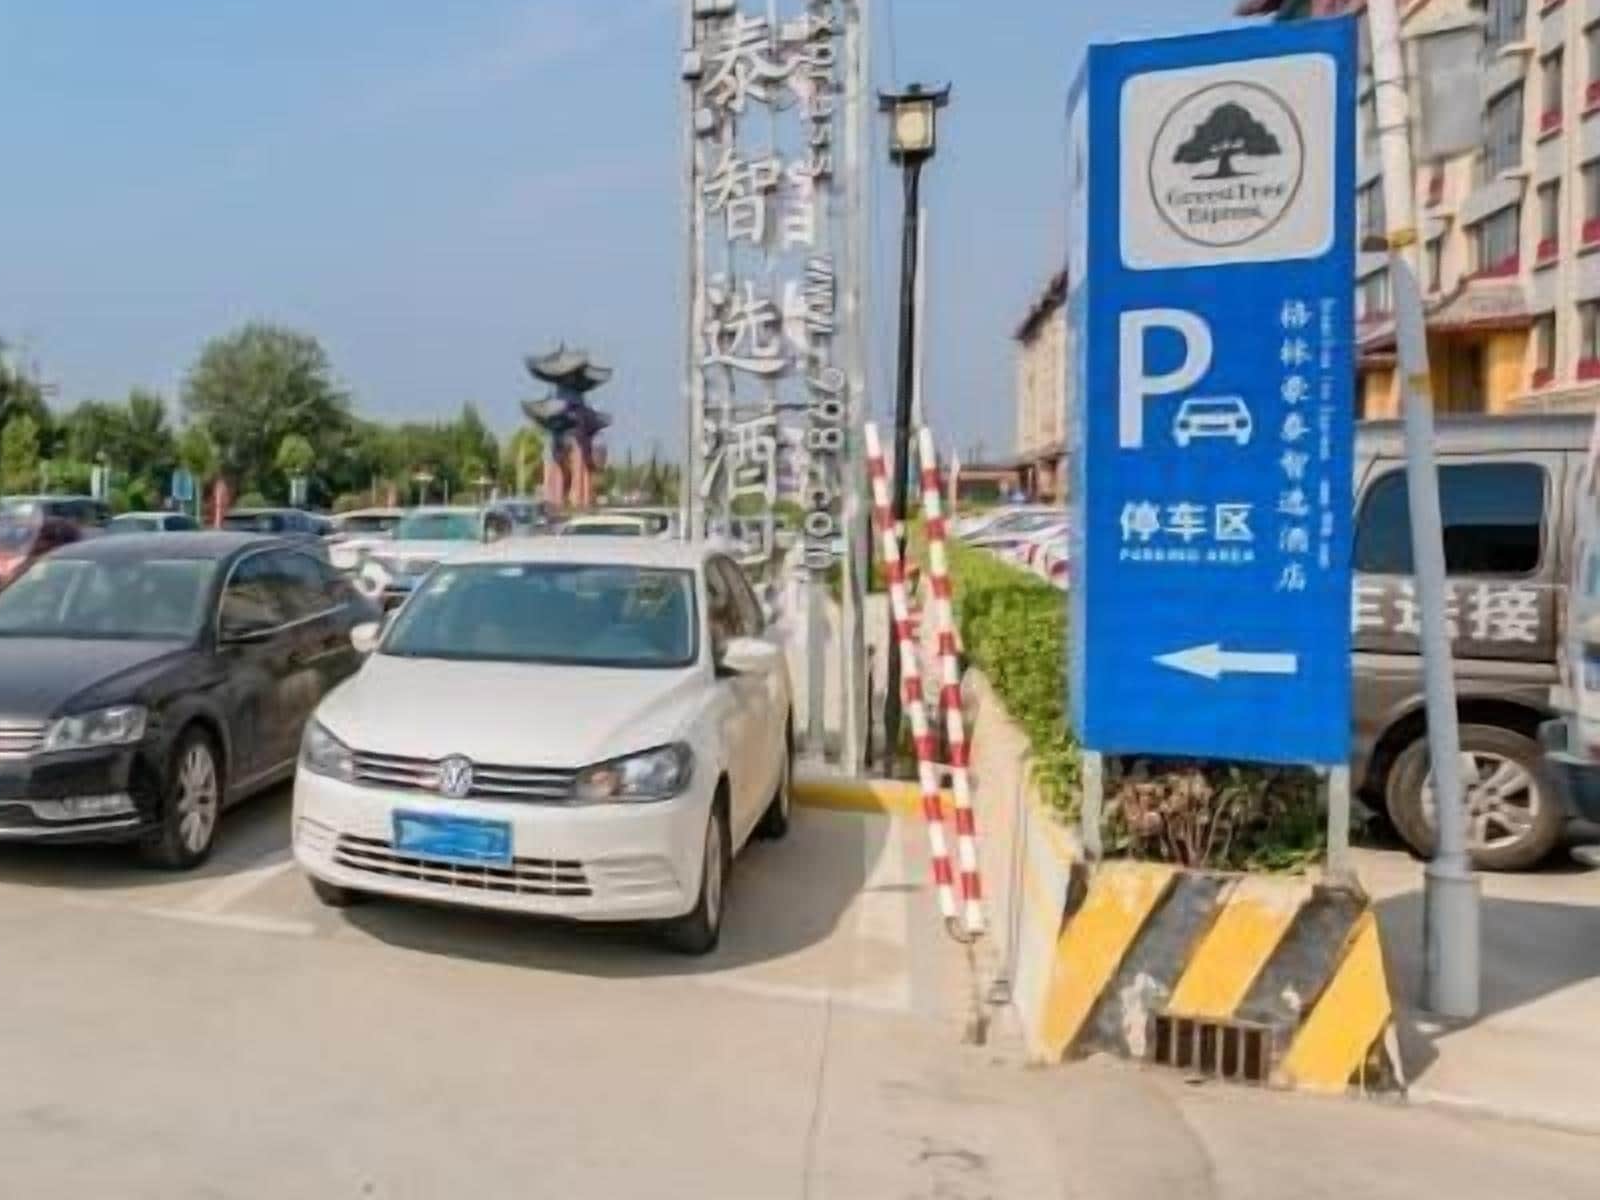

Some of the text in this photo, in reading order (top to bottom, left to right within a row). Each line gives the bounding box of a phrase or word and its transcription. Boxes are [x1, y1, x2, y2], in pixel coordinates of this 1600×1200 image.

[1119, 309, 1214, 449] P
[1120, 500, 1255, 542] 停车区
